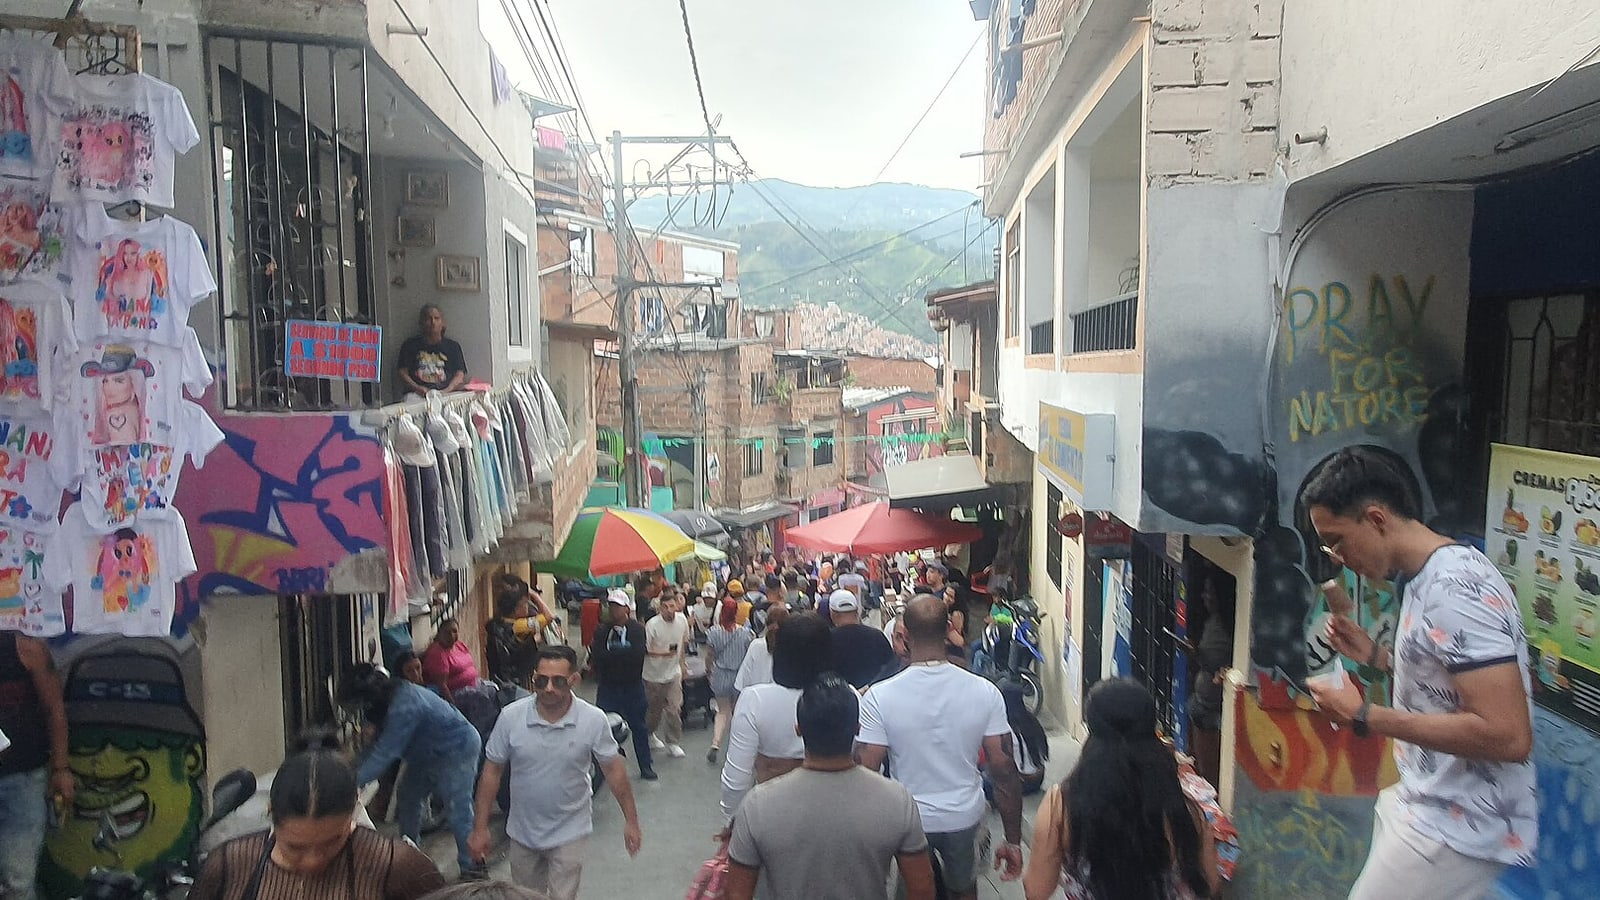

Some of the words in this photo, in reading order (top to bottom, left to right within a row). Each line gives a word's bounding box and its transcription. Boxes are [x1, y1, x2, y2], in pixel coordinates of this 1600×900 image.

[1284, 272, 1437, 367] PRAY
[290, 322, 336, 340] SERVICIO
[338, 327, 349, 341] DE
[290, 340, 304, 357] A
[290, 357, 345, 378] SEGUNDO
[348, 362, 376, 379] PISO
[1330, 349, 1425, 394] FOR
[1289, 386, 1430, 442] NATORE
[1513, 470, 1566, 493] CREMAS
